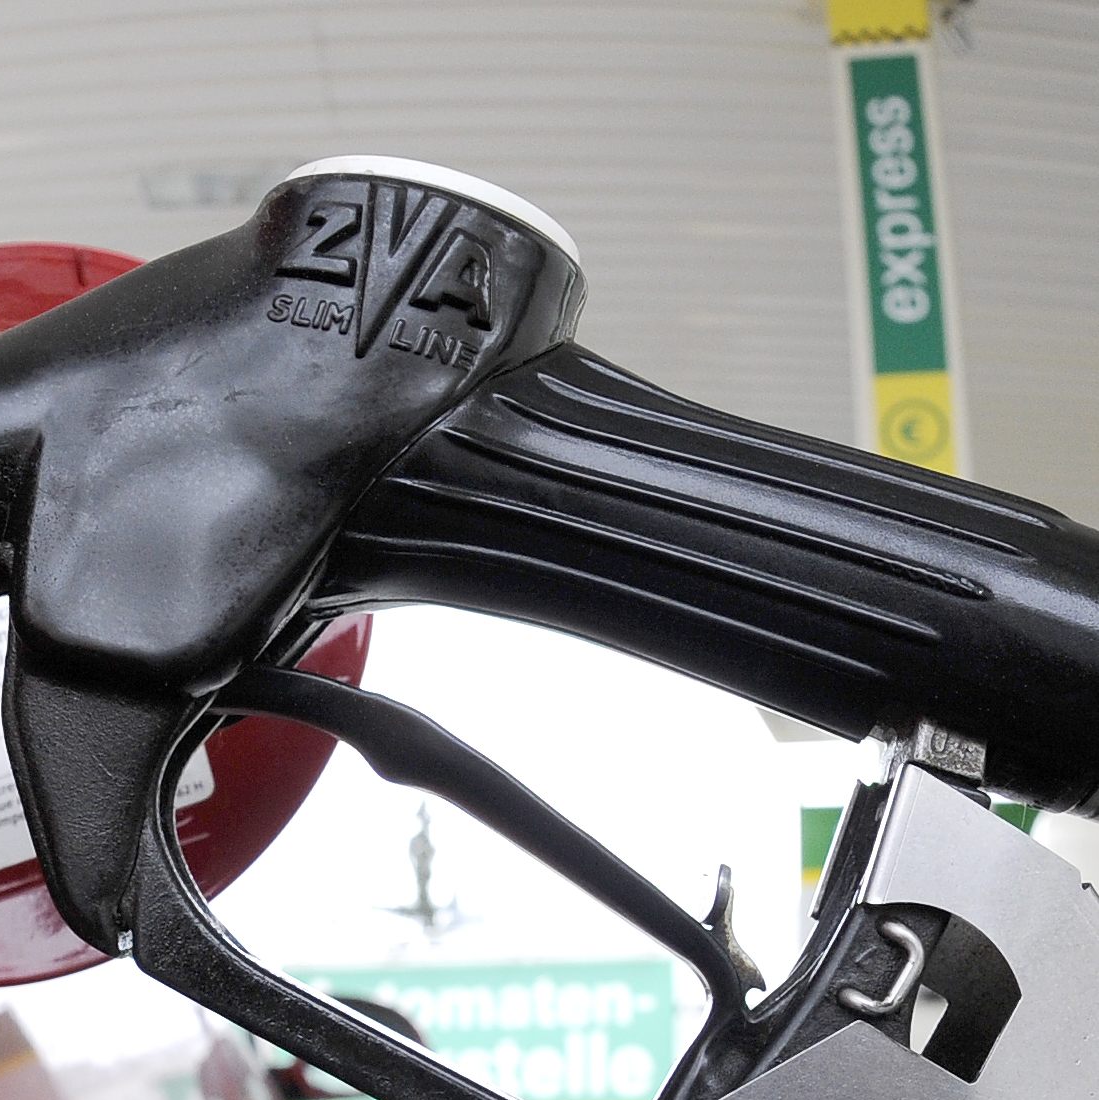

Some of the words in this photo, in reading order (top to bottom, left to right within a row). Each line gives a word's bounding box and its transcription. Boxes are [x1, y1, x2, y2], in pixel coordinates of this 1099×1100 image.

[275, 181, 495, 358] ZVA
[864, 95, 936, 324] express
[267, 294, 355, 335] SLIM
[387, 319, 481, 372] LINE
